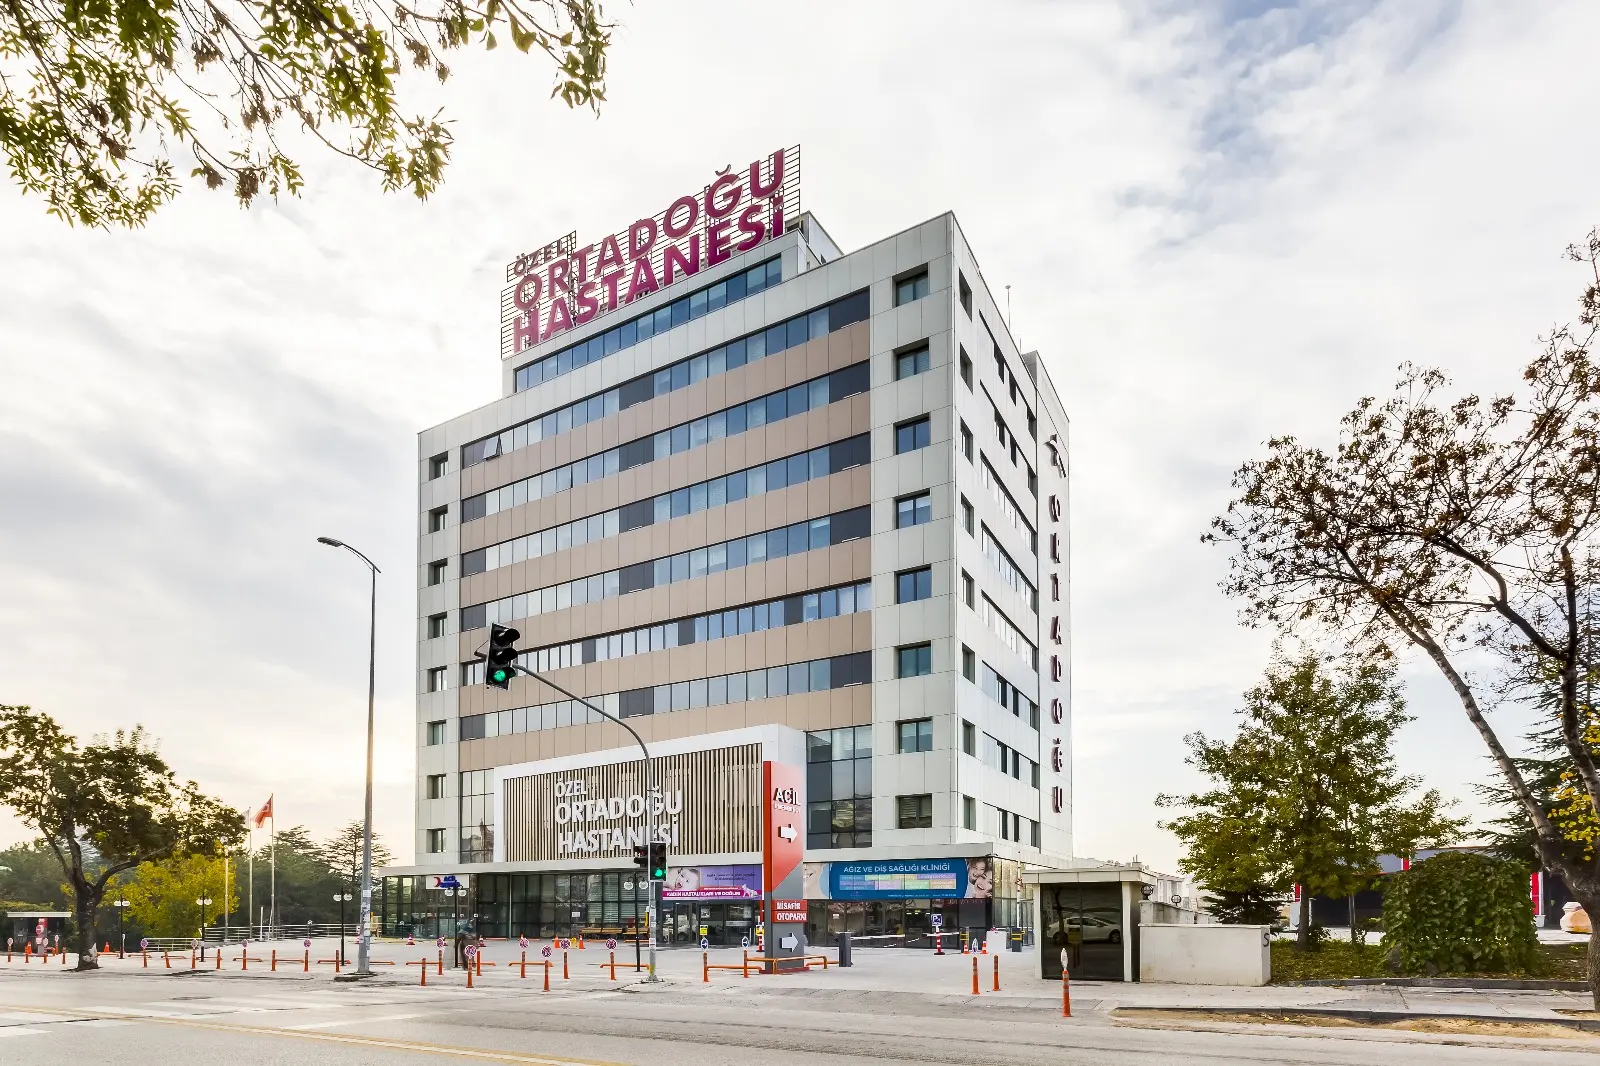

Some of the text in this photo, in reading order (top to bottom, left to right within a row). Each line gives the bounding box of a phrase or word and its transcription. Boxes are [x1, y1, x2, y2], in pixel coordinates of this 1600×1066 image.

[513, 147, 785, 312] ORTADOĞU
[513, 239, 566, 277] ÖZEL
[513, 194, 785, 354] HASTANESİ
[554, 778, 588, 798] ÖZEL
[774, 787, 801, 806] ACİL
[554, 785, 683, 825] ORTADOĞU
[843, 865, 861, 873] AĞIZ
[874, 864, 887, 873] DİŞ
[888, 863, 919, 872] SAĞLIĞI
[921, 862, 951, 872] KLİNİĞİ
[776, 900, 801, 910] MİSAFİR
[776, 912, 807, 921] OTOPARKI
